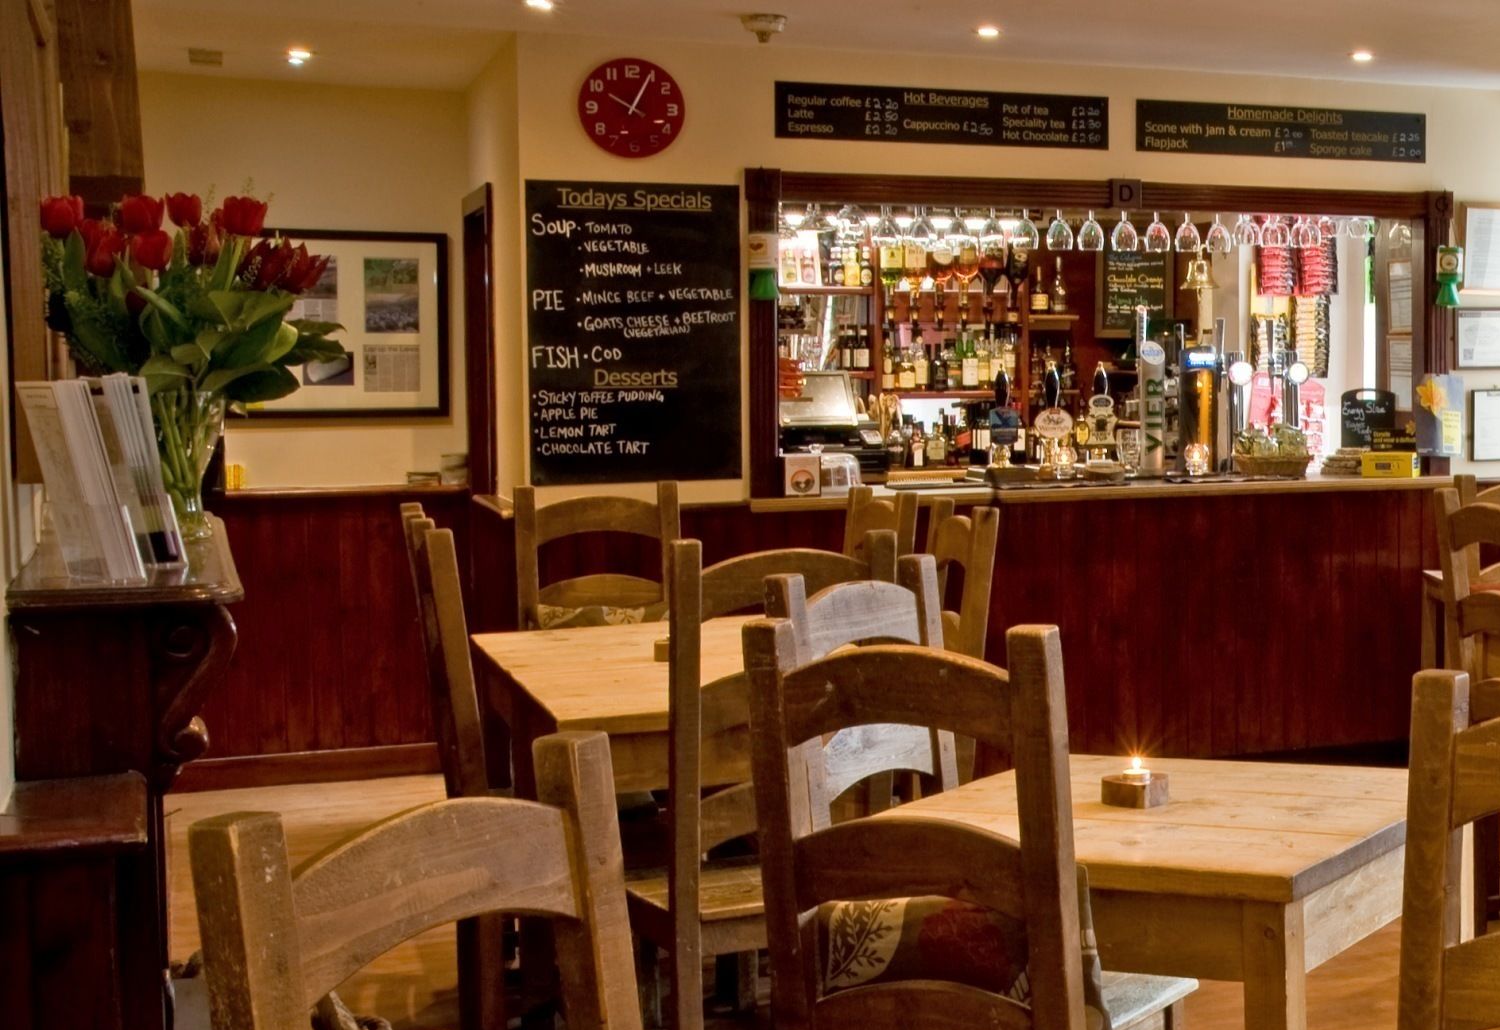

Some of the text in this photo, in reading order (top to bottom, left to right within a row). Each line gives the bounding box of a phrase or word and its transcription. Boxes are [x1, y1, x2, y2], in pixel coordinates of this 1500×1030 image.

[606, 67, 617, 81] 11
[624, 64, 640, 79] 12
[589, 79, 604, 92] 10
[661, 82, 671, 95] 2
[585, 100, 599, 114] 9
[787, 94, 826, 107] Regular
[830, 96, 862, 108] coffee
[903, 92, 989, 109] Hot Beverages
[666, 103, 679, 117] 3
[787, 108, 815, 119] Latte
[1002, 103, 1019, 114] Pot
[1020, 104, 1032, 115] of
[1033, 106, 1049, 116] tea
[1227, 106, 1344, 125] Homemade Delights
[595, 122, 606, 136] 8
[661, 123, 671, 135] 4
[787, 121, 834, 134] Espresso
[903, 118, 960, 132] Cappuccino
[1002, 116, 1048, 130] Speciality
[1050, 119, 1066, 129] tea
[1144, 121, 1177, 134] Scone
[1180, 123, 1203, 135] with
[1206, 124, 1226, 137] jam
[1228, 125, 1237, 137] &
[1240, 127, 1272, 138] cream
[1002, 130, 1021, 140] Hot
[1022, 130, 1070, 142] Chocolate
[1310, 128, 1348, 141] Toasted
[1351, 131, 1389, 143] teacake
[1144, 136, 1189, 151] Flapjack
[1310, 143, 1349, 157] Sponge
[1350, 145, 1373, 156] cake
[557, 187, 712, 212] Todays Specials
[584, 221, 633, 235] TOMATO
[583, 239, 650, 255] VEGETABLE
[584, 262, 642, 278] MUSHROOM
[653, 262, 683, 275] LEEK
[532, 289, 565, 311] PIE
[582, 290, 622, 305] MINCE
[626, 290, 655, 304] BEEF
[668, 288, 734, 301] VEGETABLE
[583, 315, 624, 332] GOATS
[626, 314, 670, 329] CHEESE
[682, 310, 737, 325] BEETROOT
[623, 325, 691, 339] (VEGETARIAN)
[531, 345, 622, 369] FISH COD
[593, 368, 679, 388] Desserts
[578, 391, 615, 404] TOFFEE
[617, 390, 665, 403] PUDDING
[540, 407, 599, 422] APPLE PIE
[540, 423, 617, 439] LEMON TART
[541, 440, 650, 456] CHOCOLATE TART
